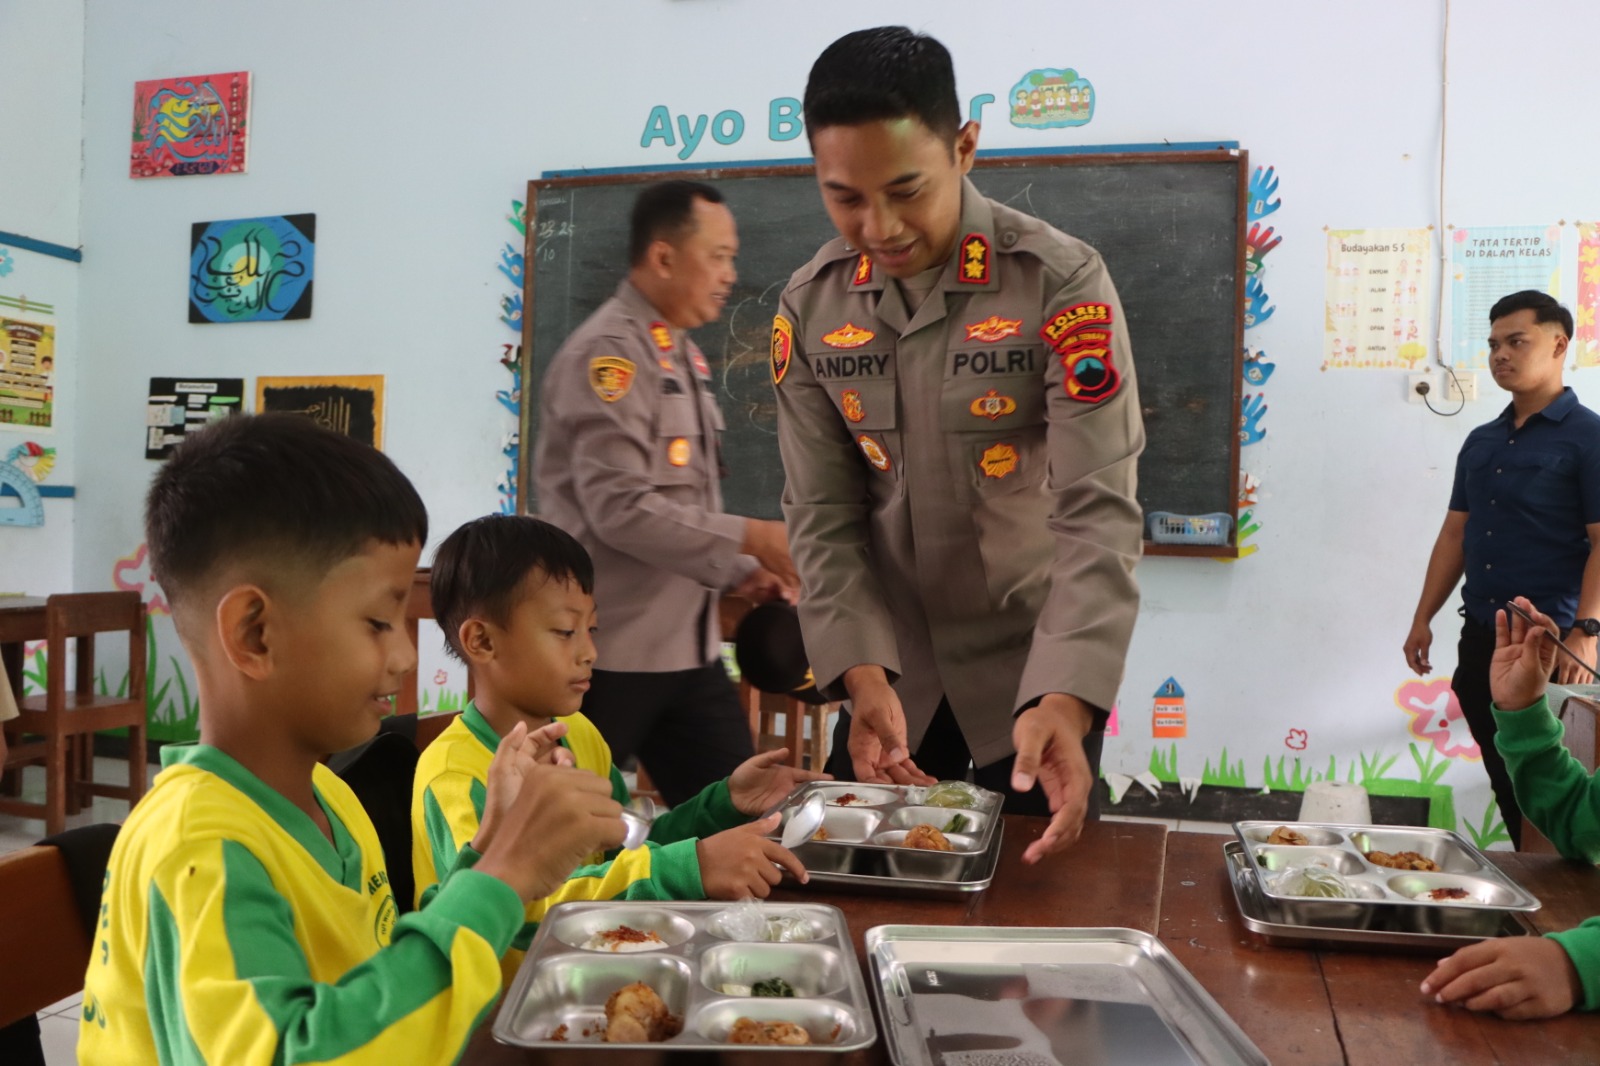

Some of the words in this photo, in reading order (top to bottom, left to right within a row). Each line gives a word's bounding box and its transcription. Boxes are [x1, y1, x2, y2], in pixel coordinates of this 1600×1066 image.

[640, 105, 744, 160] Ayo
[1341, 243, 1390, 255] Budayakan
[1465, 249, 1476, 258] DI
[1479, 249, 1515, 258] DALAM
[1519, 247, 1552, 257] KELAS
[1472, 238, 1499, 247] TATA
[1503, 236, 1541, 247] TERTIB
[1045, 305, 1107, 336] POLRES
[815, 353, 890, 378] ANDRY
[952, 349, 1035, 376] POLRI
